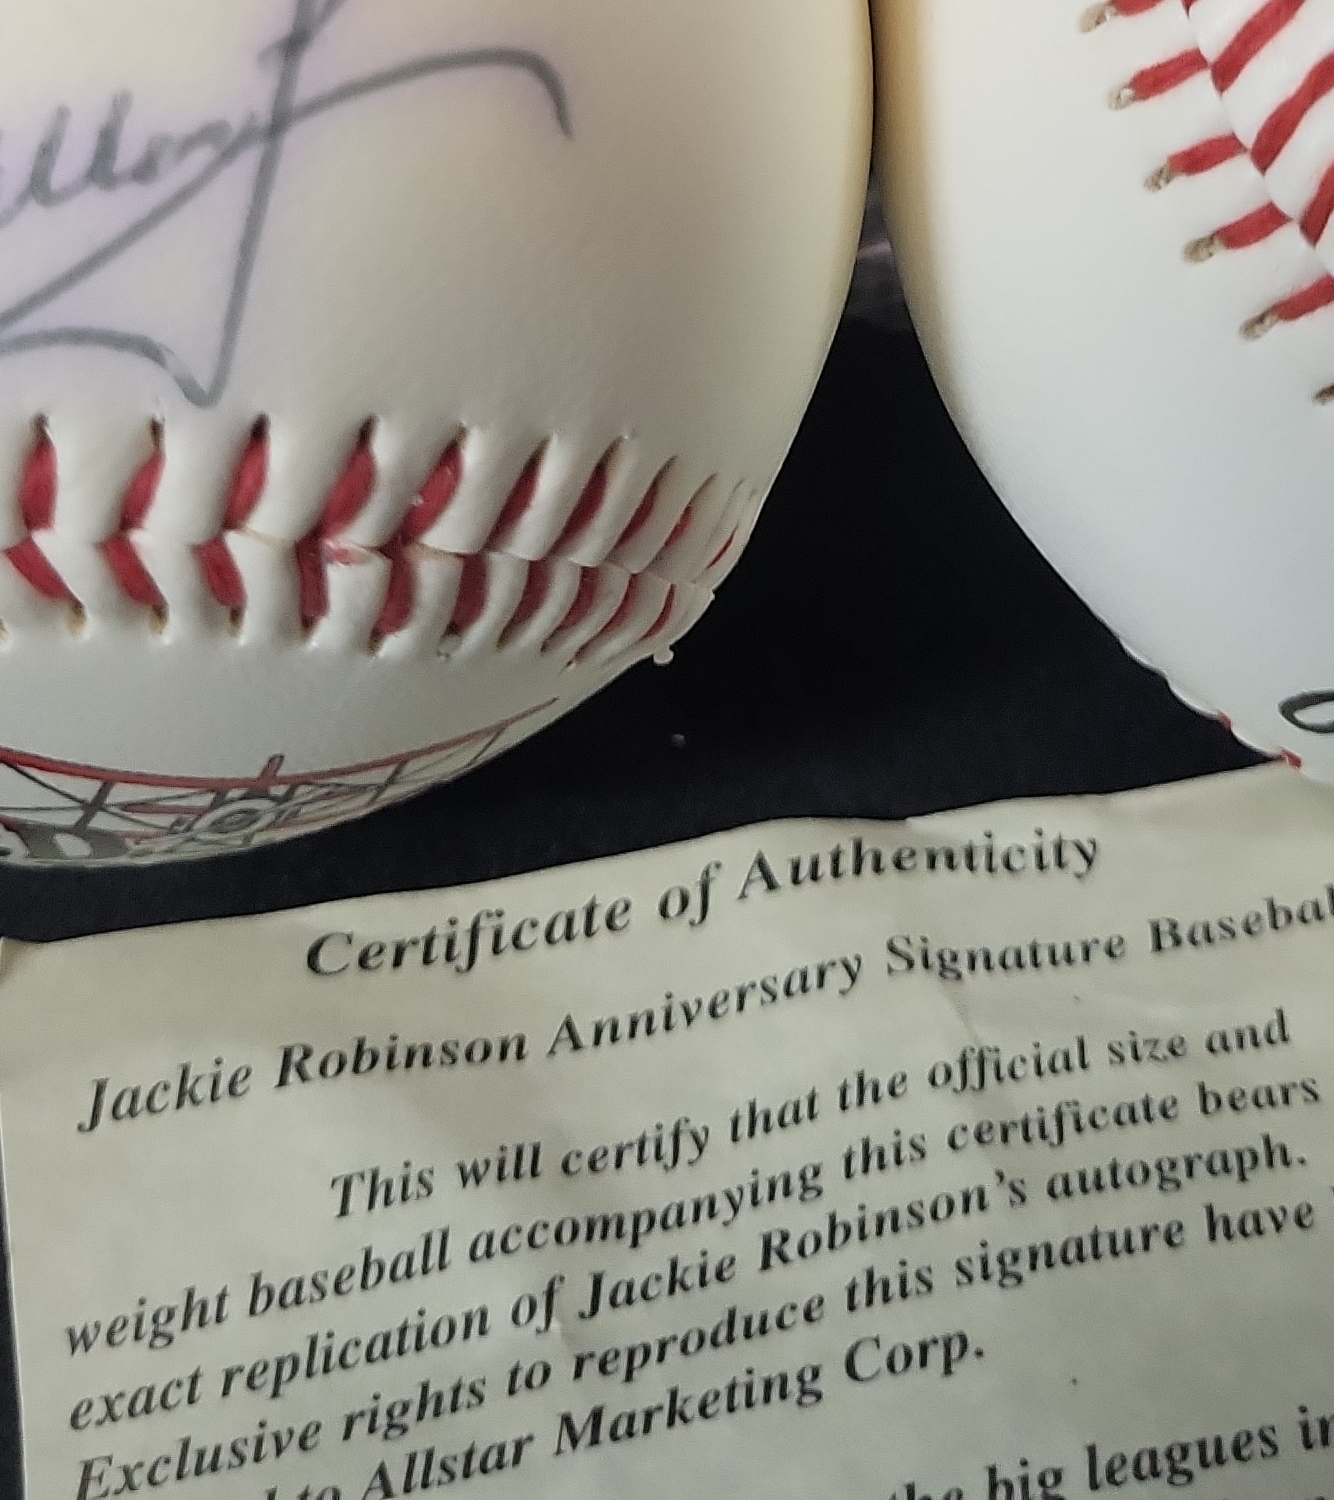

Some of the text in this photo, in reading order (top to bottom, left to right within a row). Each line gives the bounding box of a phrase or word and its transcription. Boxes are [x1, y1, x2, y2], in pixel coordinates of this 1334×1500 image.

[307, 826, 1101, 976] Certificate of Authenticity
[77, 1055, 253, 1134] Jackie
[274, 1032, 528, 1090] Robinson
[545, 950, 863, 1058] Anniversary
[885, 932, 1126, 981] Signature
[331, 1007, 1291, 1219] This will certify that the official size and
[65, 1284, 230, 1358] weight
[247, 1226, 451, 1318] baseball
[468, 1155, 822, 1264] accompanying
[841, 1128, 927, 1182] this
[947, 1094, 1179, 1153] certificate
[1197, 1077, 1320, 1117] bears
[69, 1133, 1308, 1431] exact replication of Jackie Robinson's autograph.
[75, 1419, 322, 1500] Exclusive
[342, 1371, 487, 1443] rights
[507, 1353, 552, 1397] to
[572, 1295, 824, 1390] reproduce
[845, 1256, 935, 1313] this
[954, 1217, 1186, 1290] signature
[1205, 1202, 1315, 1243] have
[360, 1428, 535, 1500] Allstar
[553, 1361, 822, 1457] Marketing
[843, 1332, 985, 1385] Corp.
[1085, 1420, 1279, 1492] leagues
